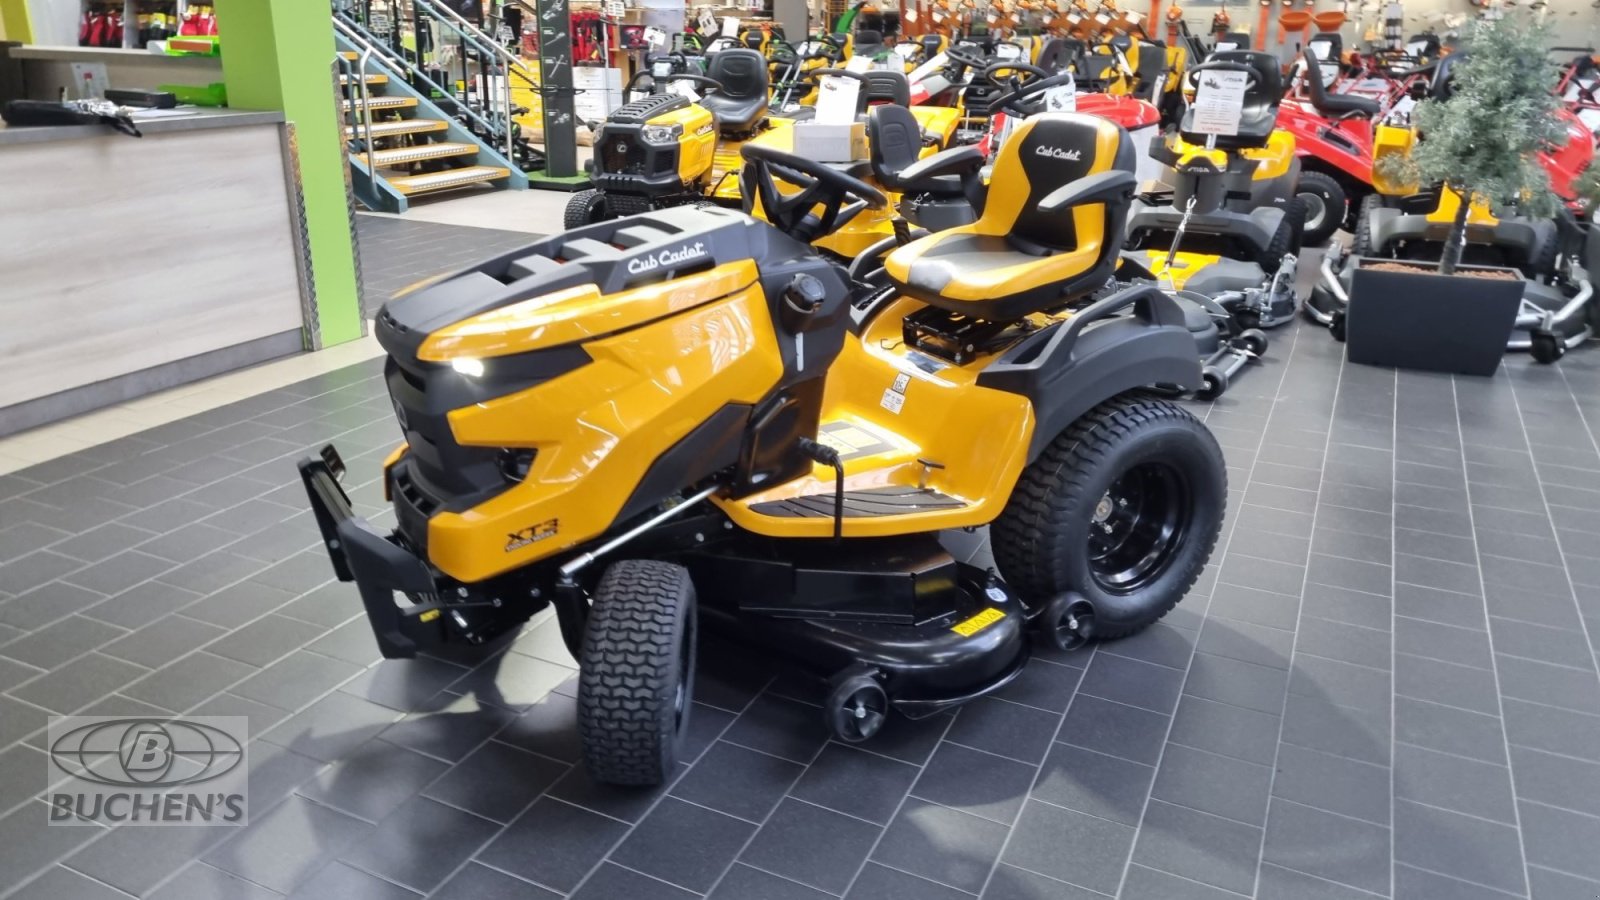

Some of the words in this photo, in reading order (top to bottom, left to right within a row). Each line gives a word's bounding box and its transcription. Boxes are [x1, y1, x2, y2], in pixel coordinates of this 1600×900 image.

[1035, 145, 1053, 157] Cub
[1052, 148, 1081, 161] Cadet
[627, 255, 658, 274] Cub
[658, 242, 705, 266] Cadet
[505, 518, 559, 547] XT3
